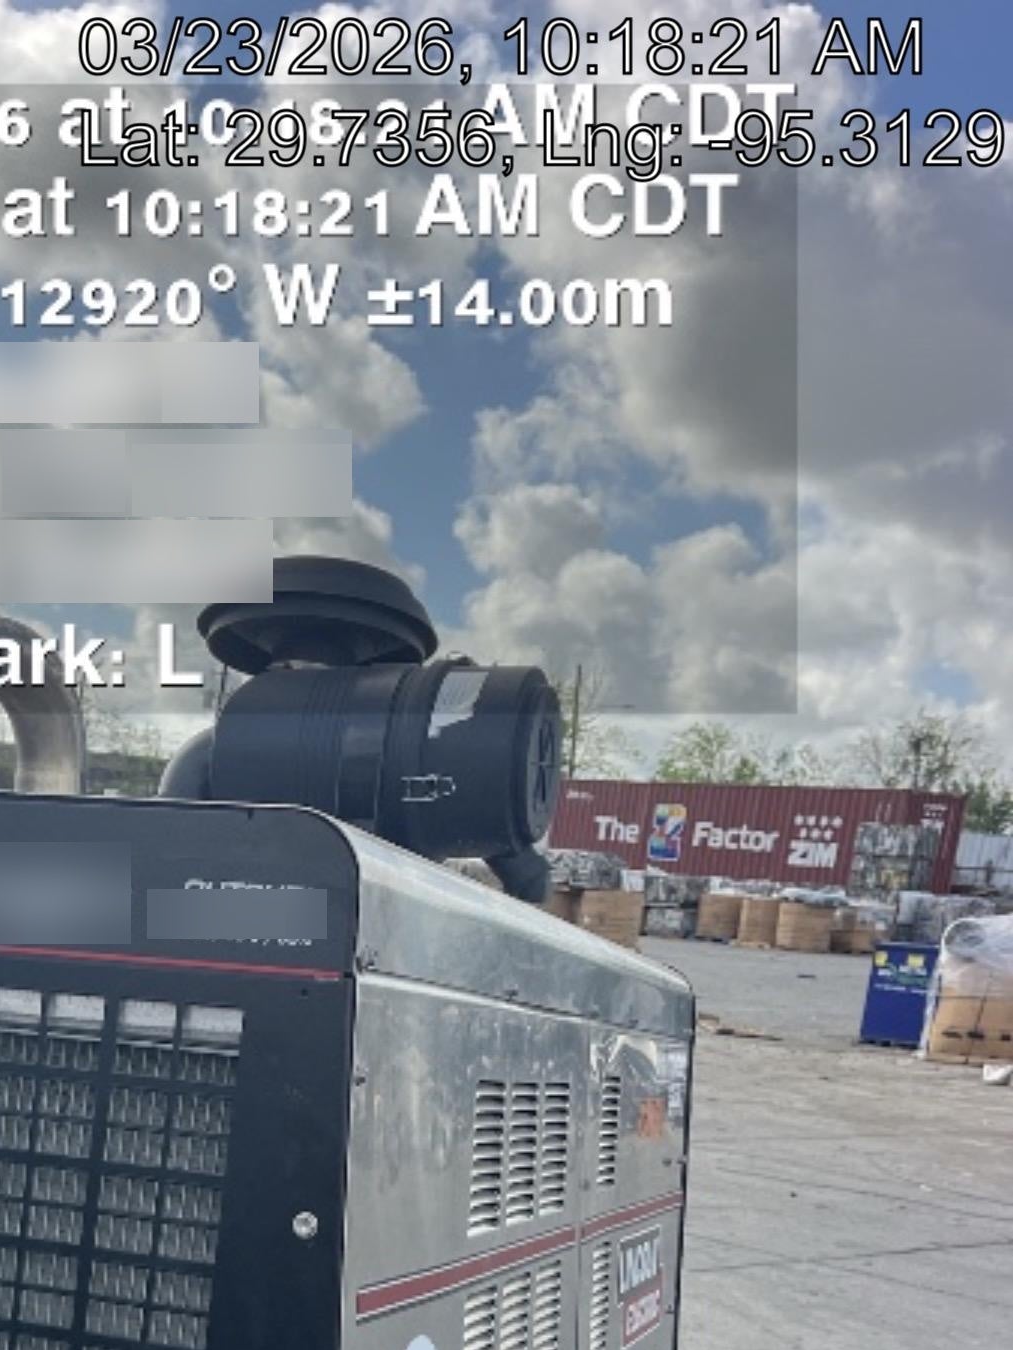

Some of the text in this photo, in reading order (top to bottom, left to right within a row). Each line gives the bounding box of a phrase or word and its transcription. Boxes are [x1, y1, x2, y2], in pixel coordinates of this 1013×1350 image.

[594, 814, 640, 844] The
[691, 819, 781, 853] Factor
[787, 839, 838, 869] ZIM
